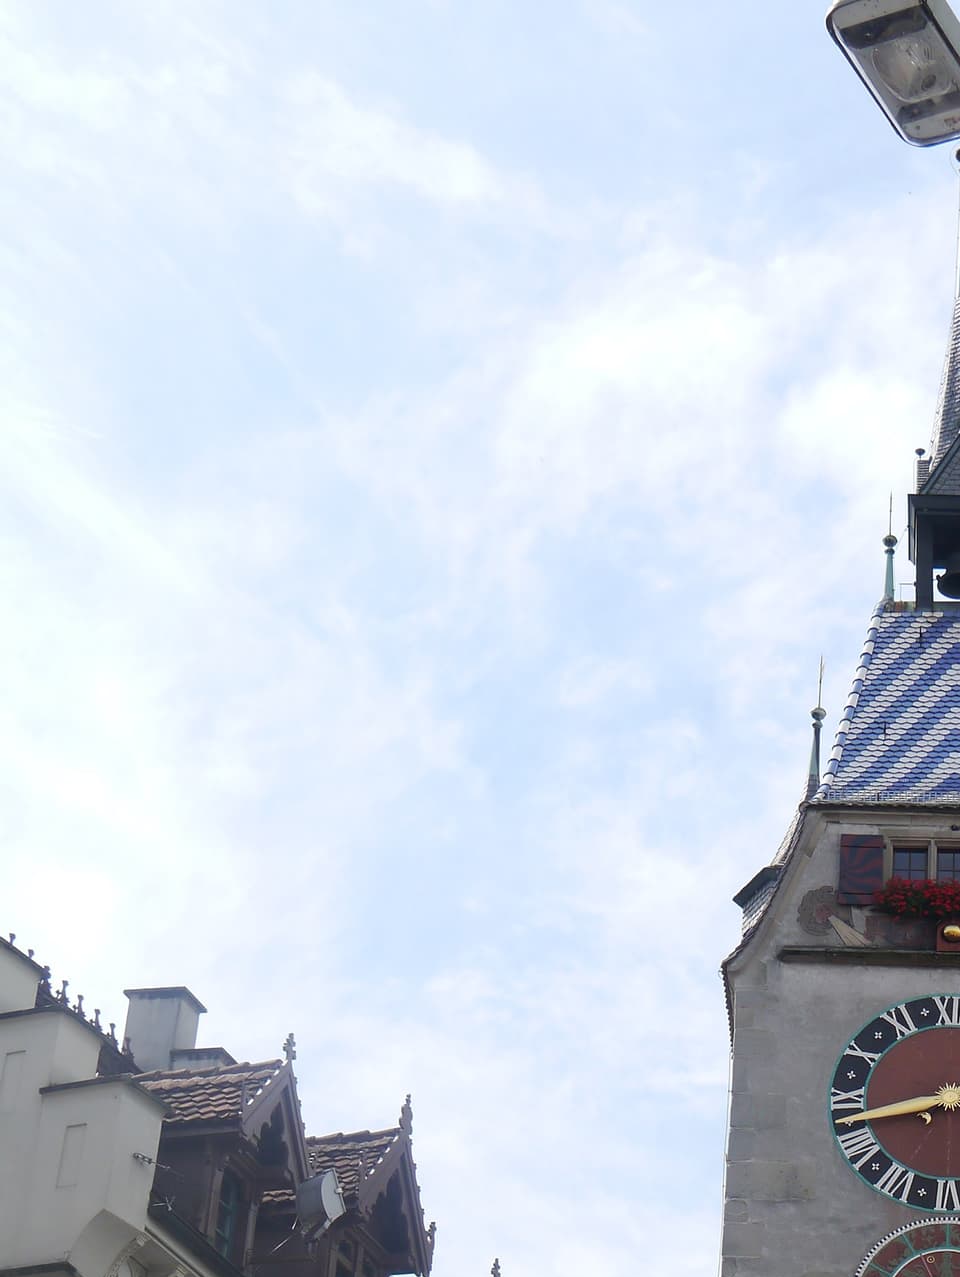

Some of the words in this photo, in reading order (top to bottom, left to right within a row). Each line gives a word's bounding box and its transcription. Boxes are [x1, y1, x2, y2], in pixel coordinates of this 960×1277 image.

[880, 1004, 918, 1040] XI
[844, 1040, 882, 1067] X
[831, 1087, 865, 1111] IX
[836, 1126, 880, 1171] VIII
[873, 1162, 915, 1203] VII
